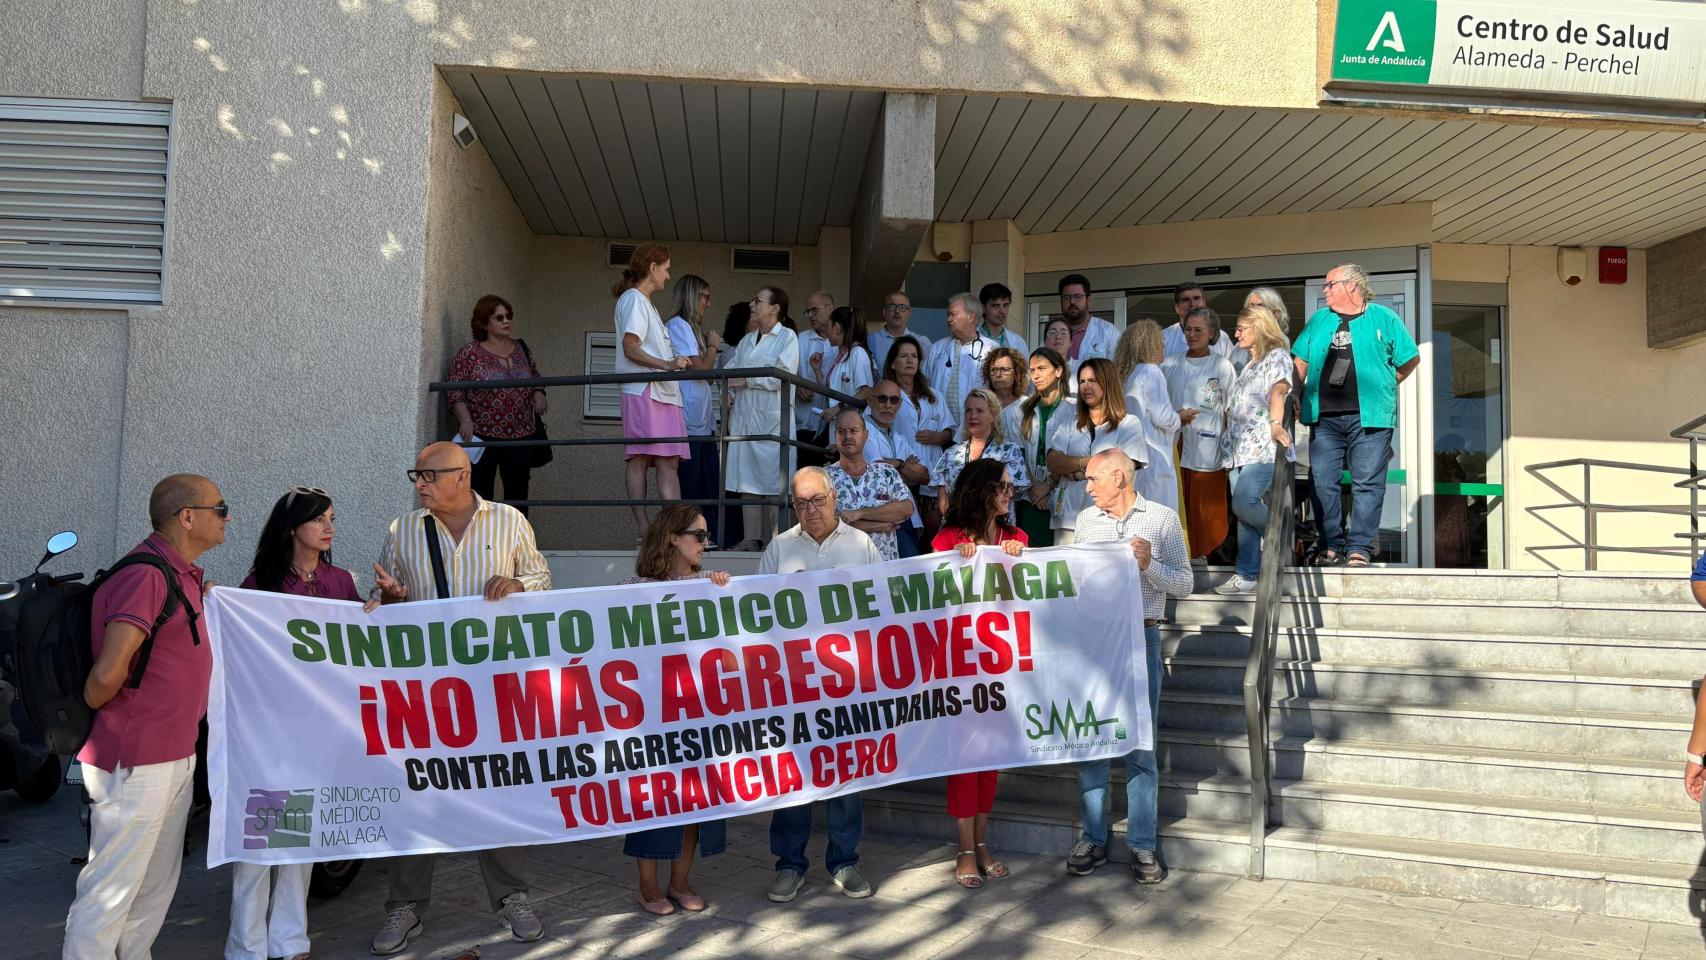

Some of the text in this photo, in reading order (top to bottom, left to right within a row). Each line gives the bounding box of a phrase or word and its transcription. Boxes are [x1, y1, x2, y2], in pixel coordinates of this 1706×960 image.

[1457, 14, 1669, 51] Centro de Salud
[1340, 54, 1426, 67] Junta de Andalucía
[1452, 45, 1545, 70] Alameda
[1564, 52, 1640, 76] Perchel
[286, 560, 1077, 668] SINDICATO MÉDICO DE MÁLAGA
[359, 611, 1034, 756] ¡NO MÁS AGRESIONES!
[405, 681, 1007, 792] CONTRA LAS AGRESIONES A SANITARIAS-OS
[1025, 697, 1119, 742] SMA
[1030, 739, 1119, 753] Sindicato Médico Andaluz
[320, 786, 400, 804] SINDICATO
[551, 732, 898, 830] TOLERANCIA CERO
[320, 804, 380, 825] MÉDICO
[321, 825, 388, 847] MÁLAGA
